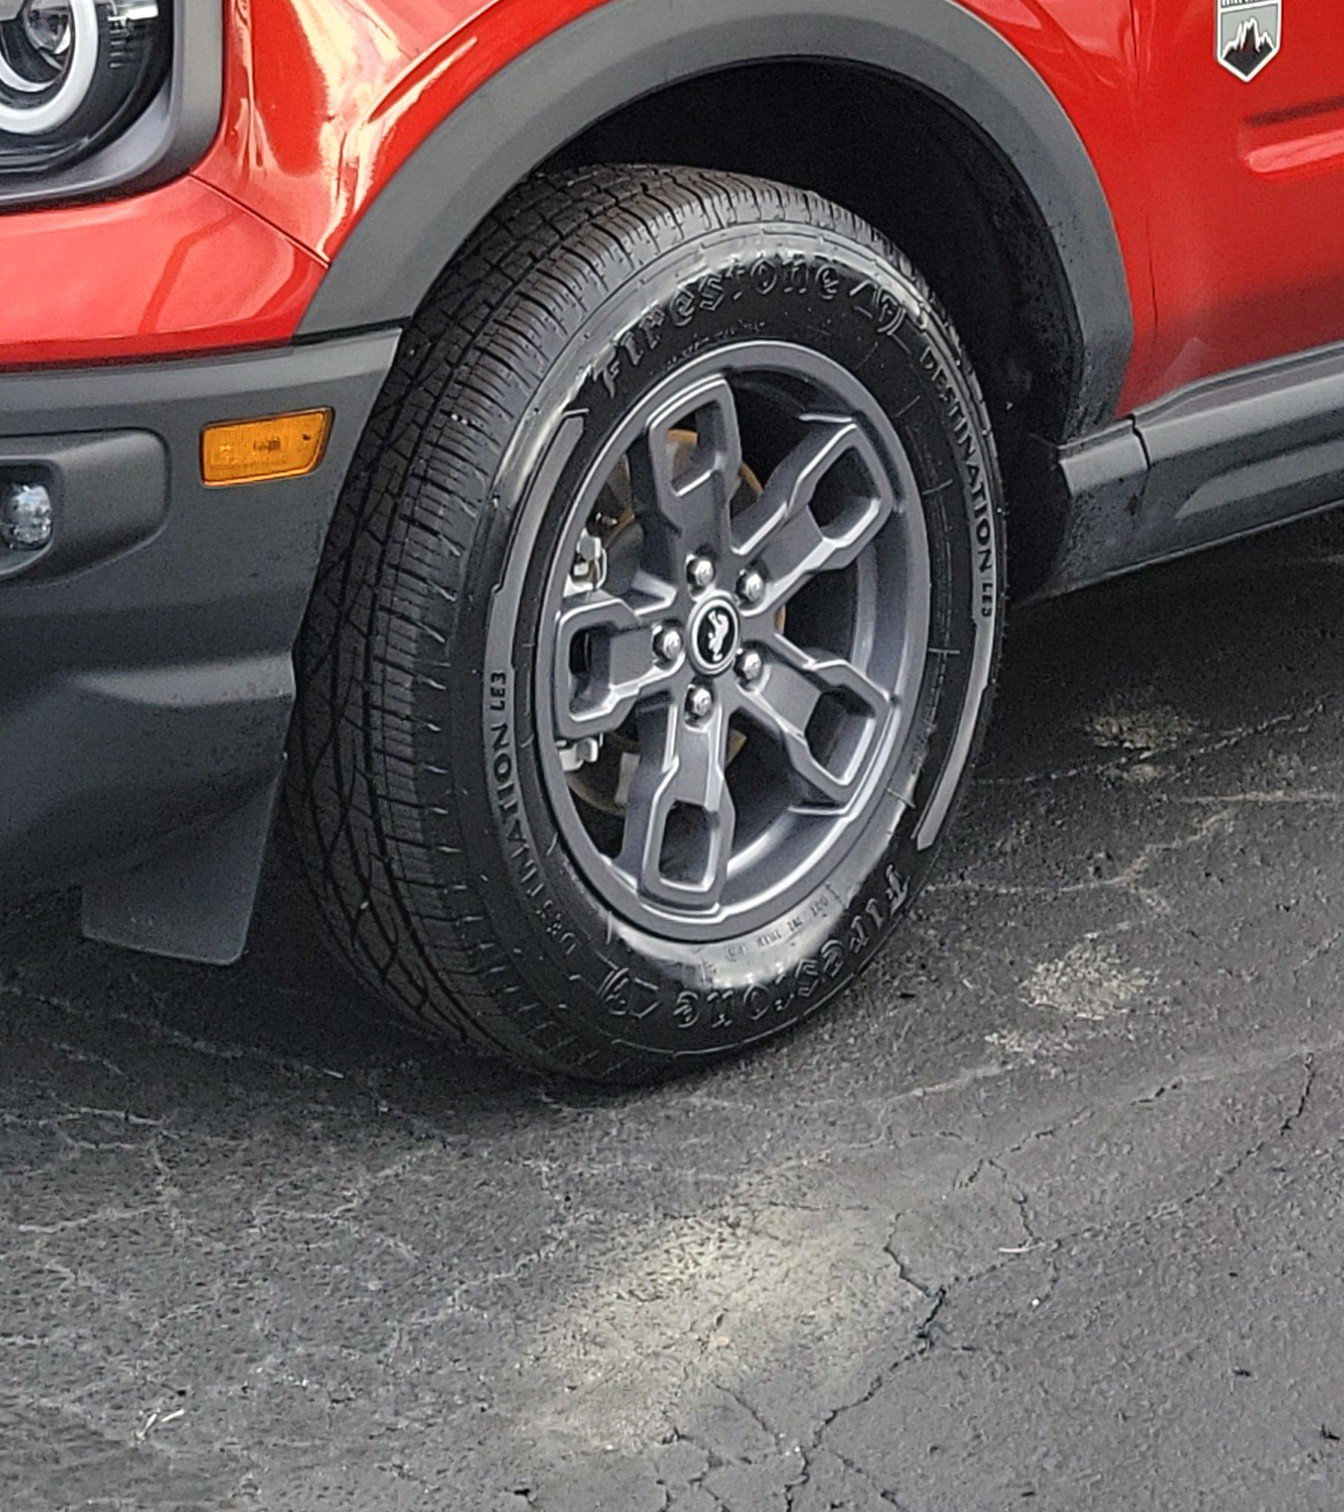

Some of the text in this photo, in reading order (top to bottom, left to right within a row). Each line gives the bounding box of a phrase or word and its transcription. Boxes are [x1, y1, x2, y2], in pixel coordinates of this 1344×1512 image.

[592, 255, 841, 400] Firestone
[919, 345, 995, 619] DESTINATION LE3
[488, 670, 507, 712] LE3
